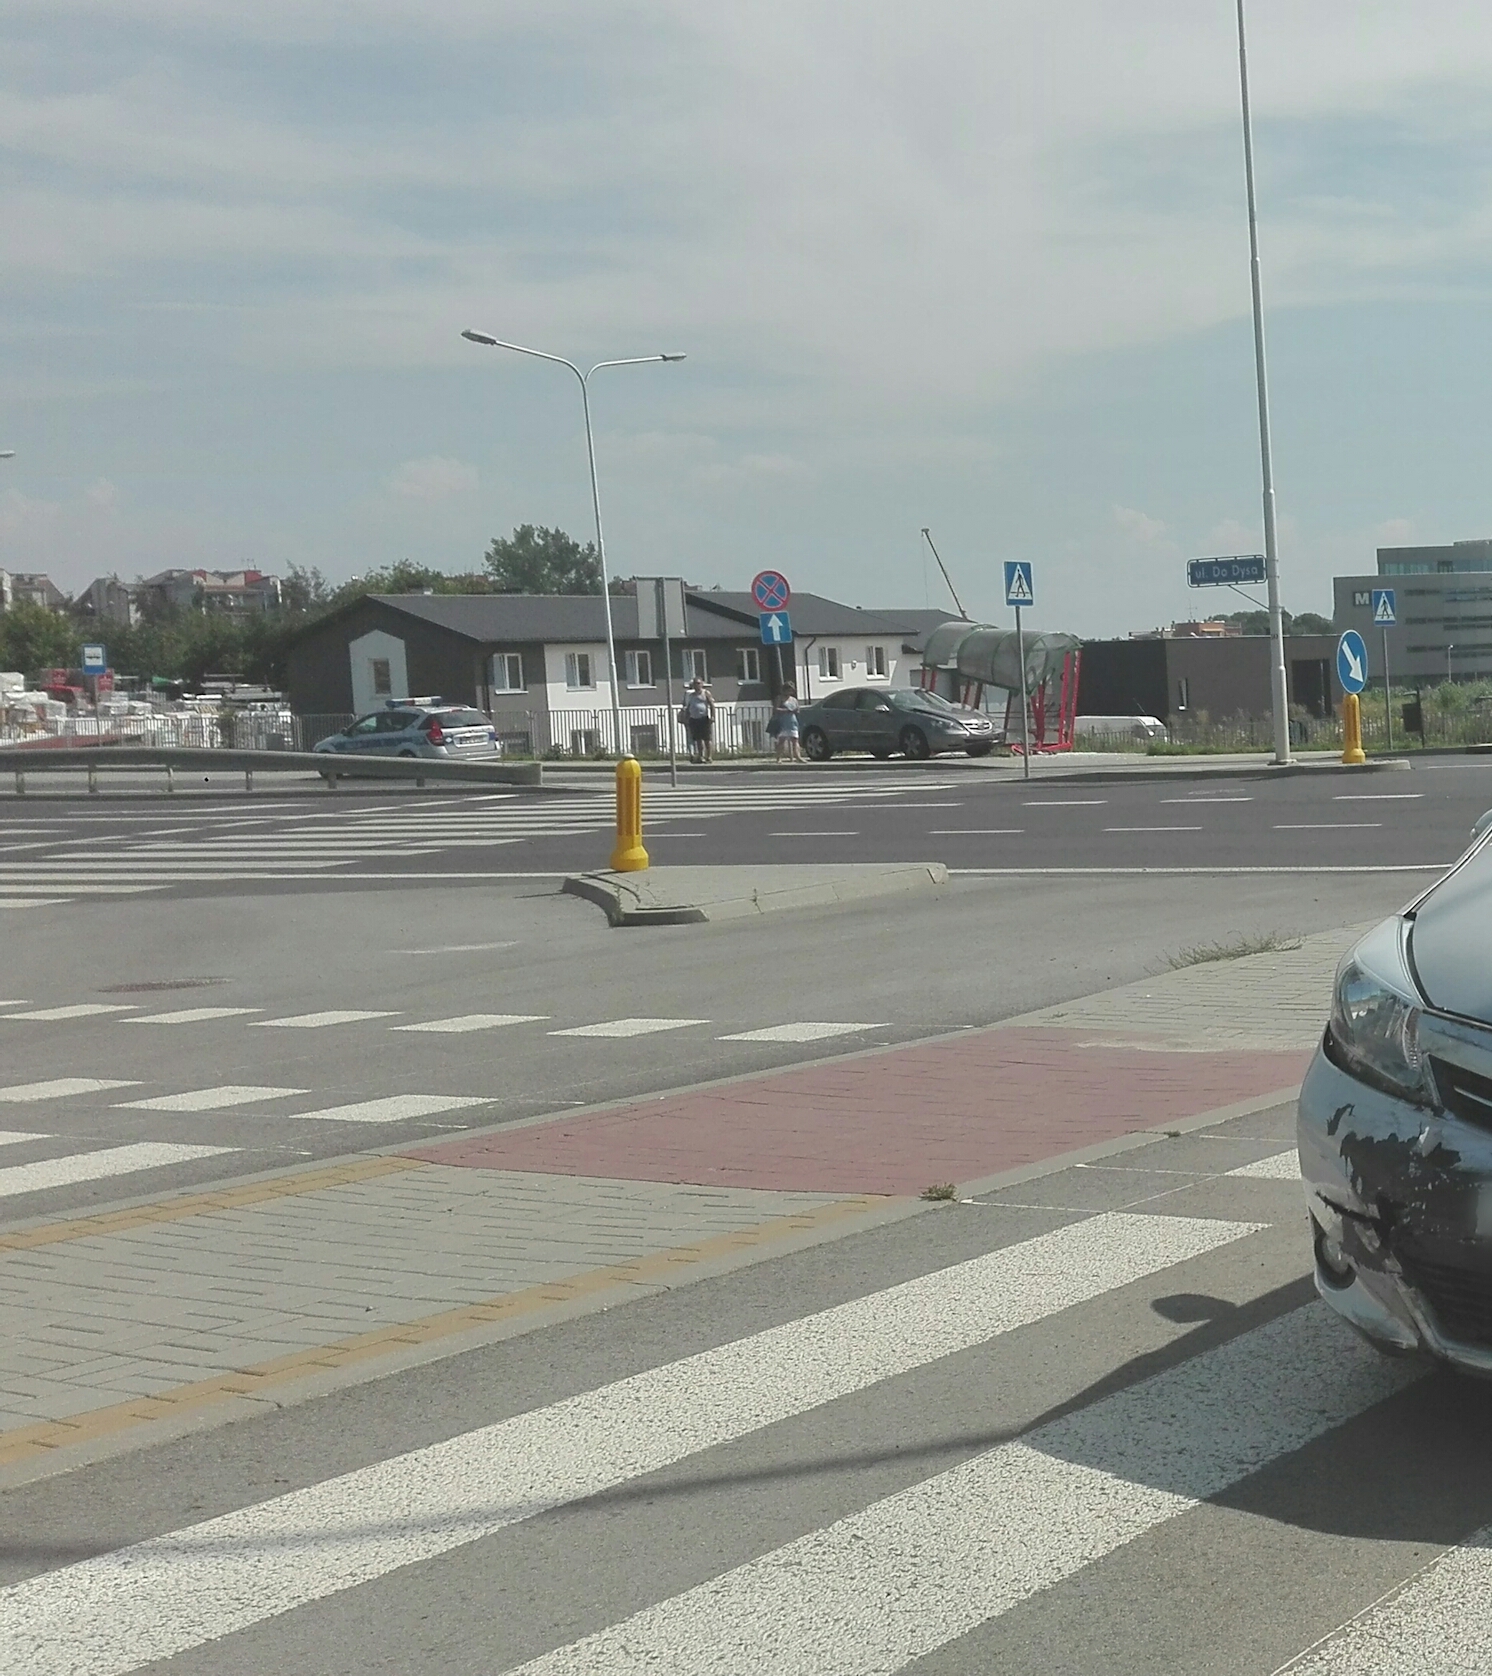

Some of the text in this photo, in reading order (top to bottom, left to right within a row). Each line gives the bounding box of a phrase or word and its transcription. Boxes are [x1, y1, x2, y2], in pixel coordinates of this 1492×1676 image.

[1194, 564, 1258, 579] ul. Do Dysa
[1354, 592, 1370, 605] M
